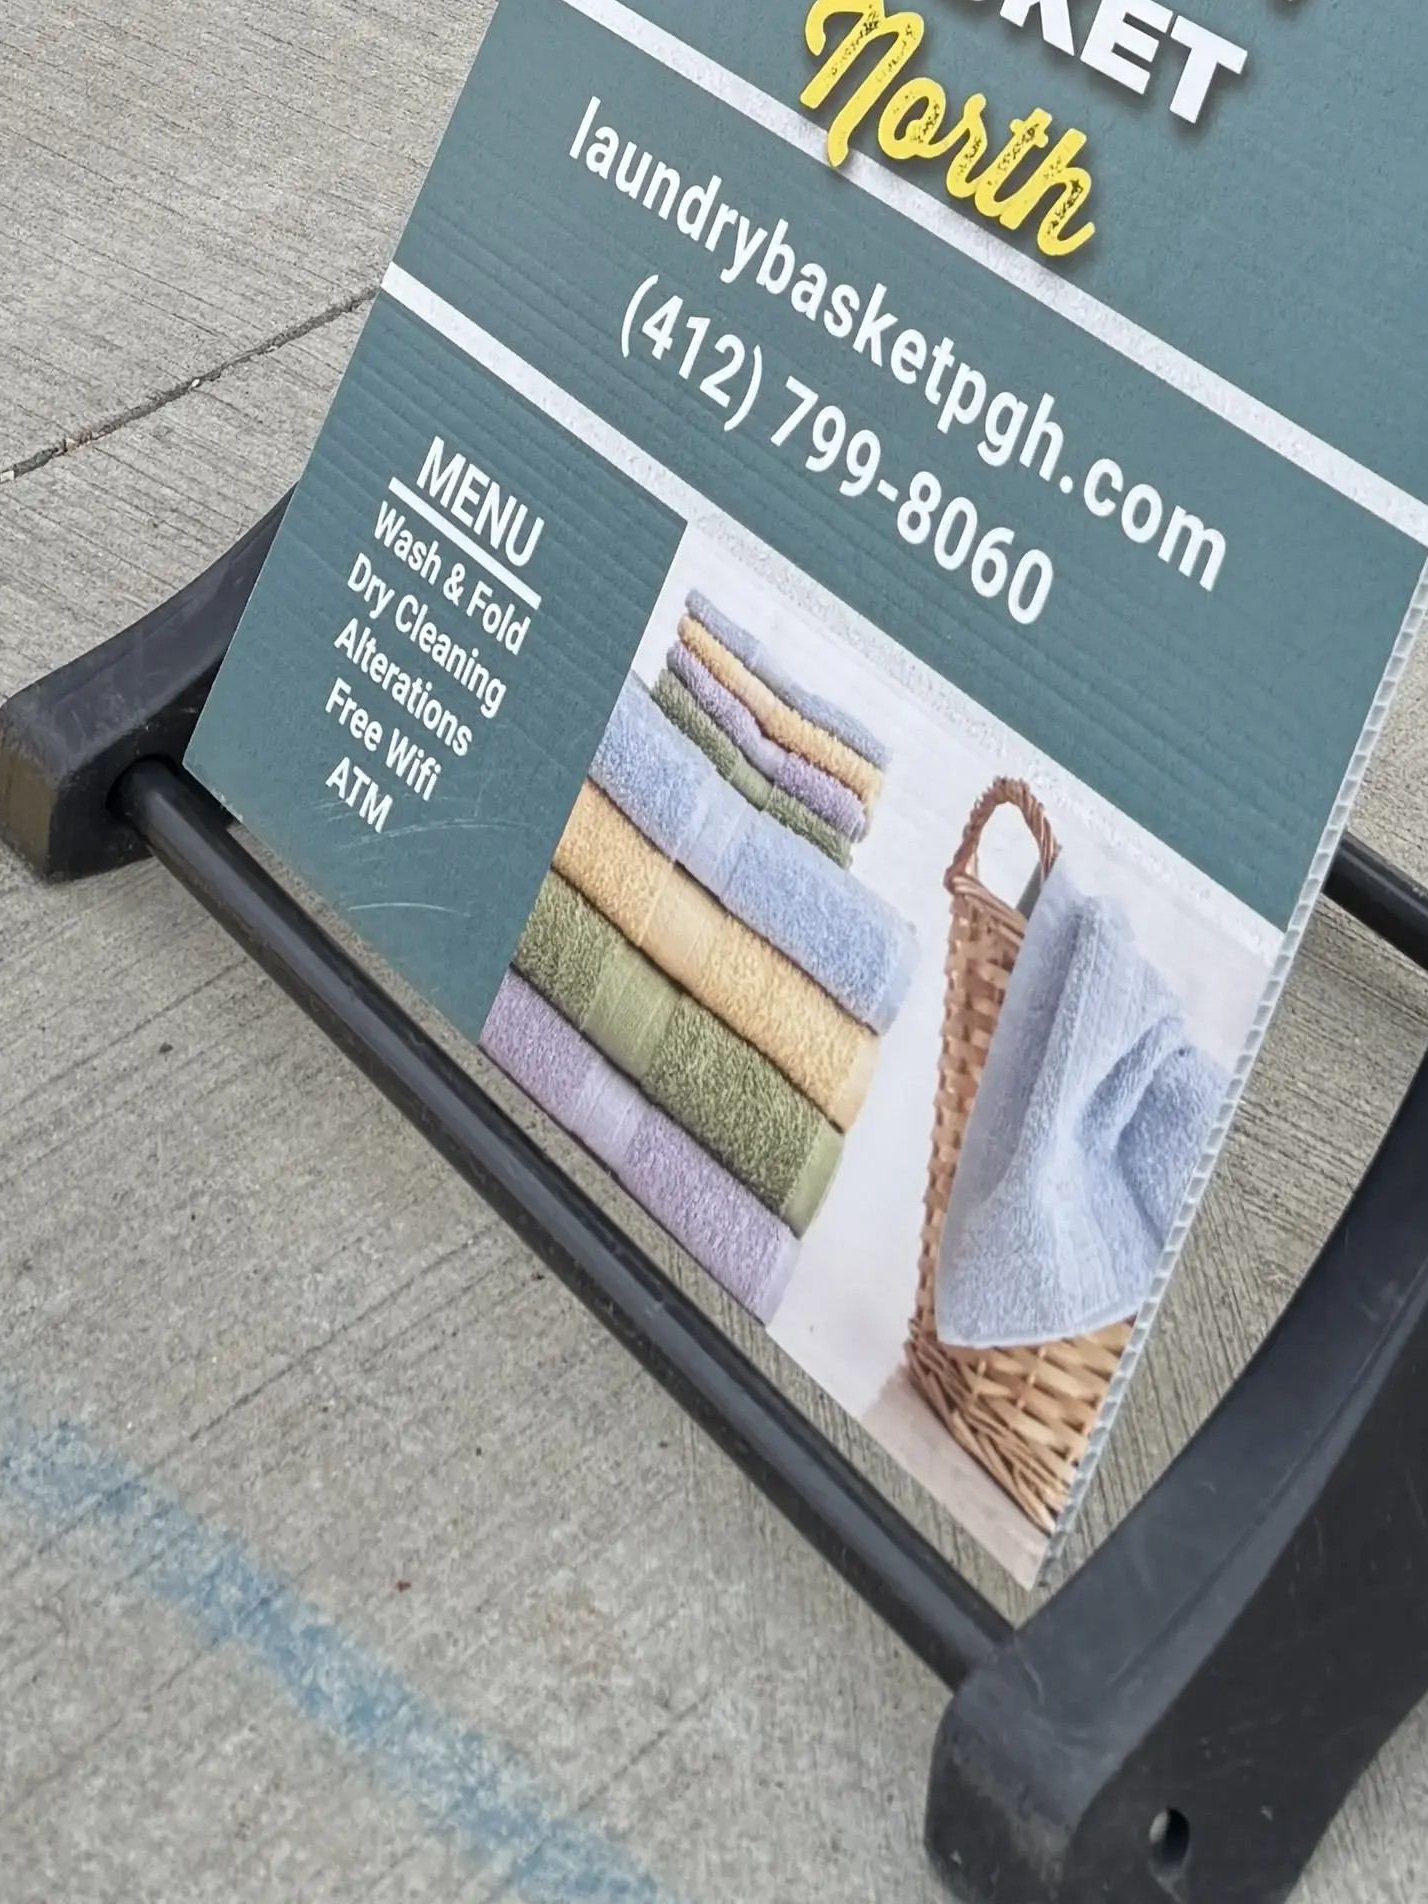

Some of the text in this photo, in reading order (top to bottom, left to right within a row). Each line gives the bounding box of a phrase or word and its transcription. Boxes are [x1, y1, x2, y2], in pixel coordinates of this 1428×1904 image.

[569, 95, 1227, 591] laundrybasketpgh.com
[416, 436, 544, 567] MENU
[620, 273, 1054, 624] (412) 799-8060
[347, 552, 506, 718] Dry Cleaning
[374, 500, 531, 655] Wash & Fold
[325, 678, 442, 801] Free Wifi
[334, 618, 472, 756] Alterations
[325, 757, 393, 834] ATM
